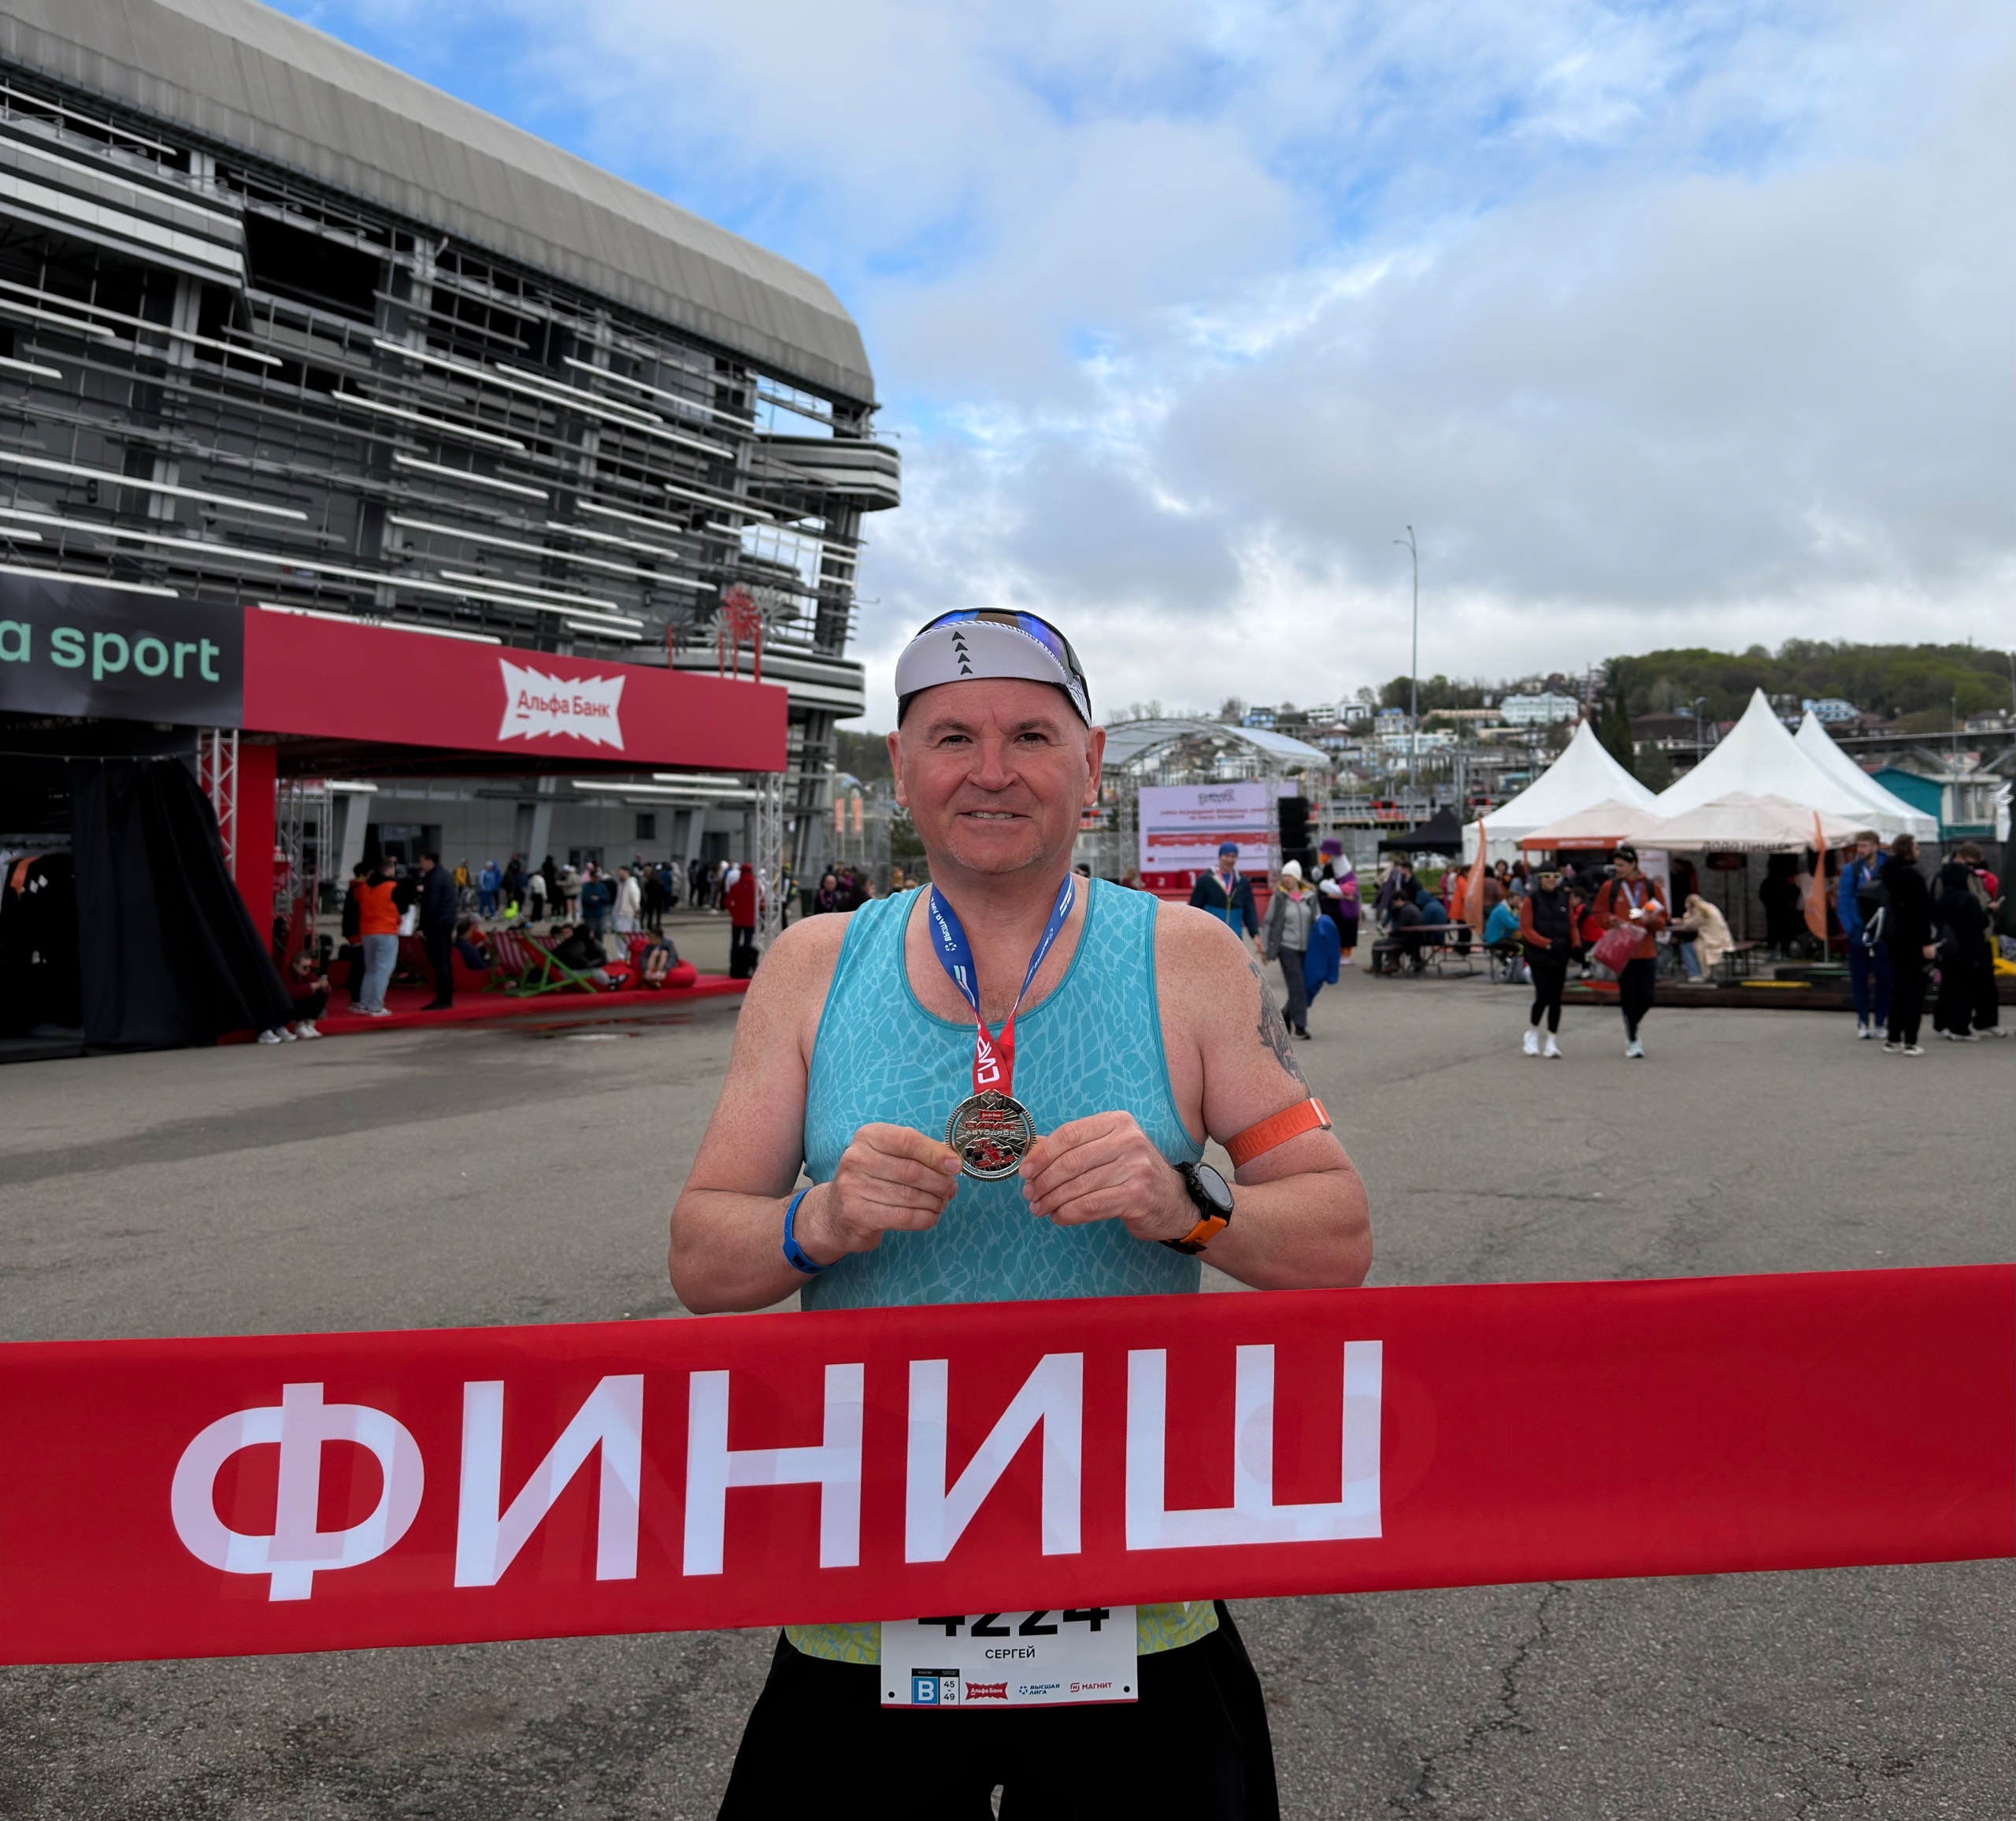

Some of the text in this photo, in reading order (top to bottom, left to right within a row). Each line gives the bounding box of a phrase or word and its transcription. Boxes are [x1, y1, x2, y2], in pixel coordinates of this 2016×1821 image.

[50, 626, 220, 682] sport
[517, 689, 610, 719] Альфа Банк
[170, 1340, 1384, 1604] ФИНИШ
[984, 1645, 1036, 1659] СЕРГЕЙ
